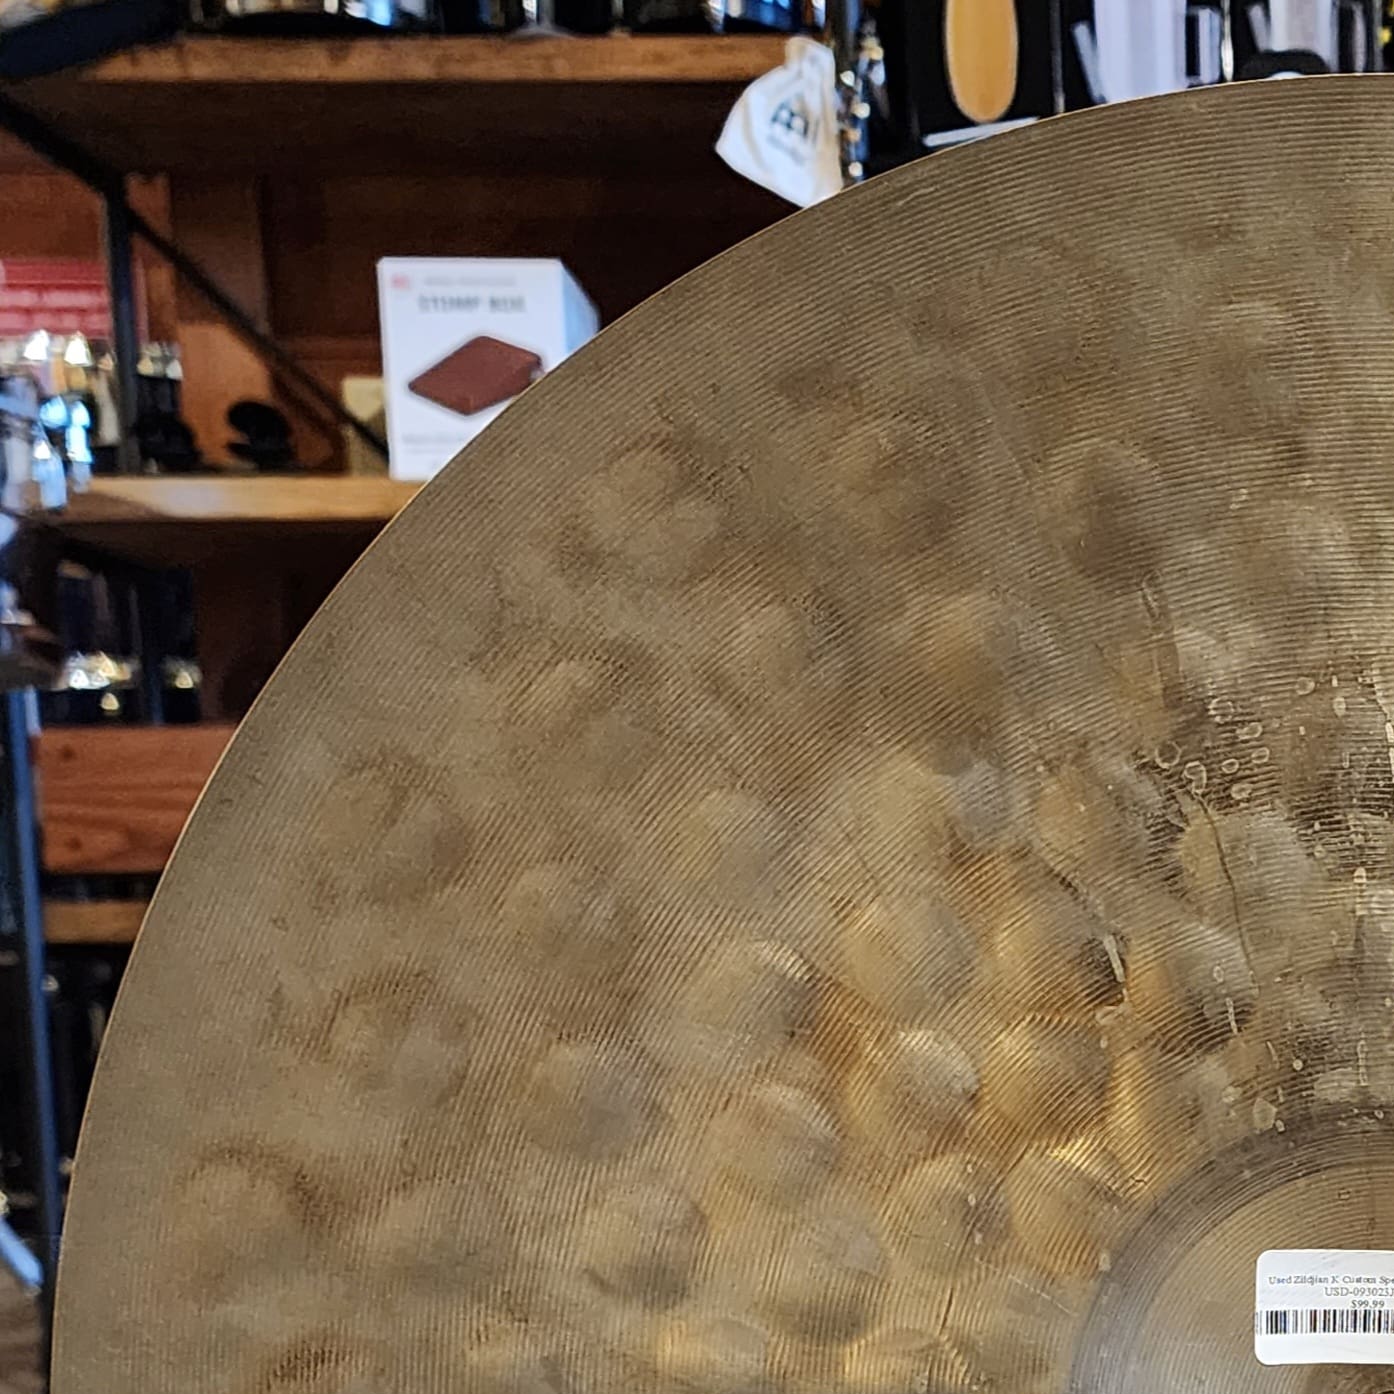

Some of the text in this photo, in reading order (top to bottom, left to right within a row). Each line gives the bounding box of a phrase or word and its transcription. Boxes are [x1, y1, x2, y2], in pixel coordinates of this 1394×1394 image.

[1268, 1275, 1293, 1285] Used
[1294, 1275, 1329, 1287] Zildjian
[1331, 1276, 1339, 1284] K
[1342, 1276, 1377, 1285] Custom
[1350, 1299, 1386, 1309] $99.99
